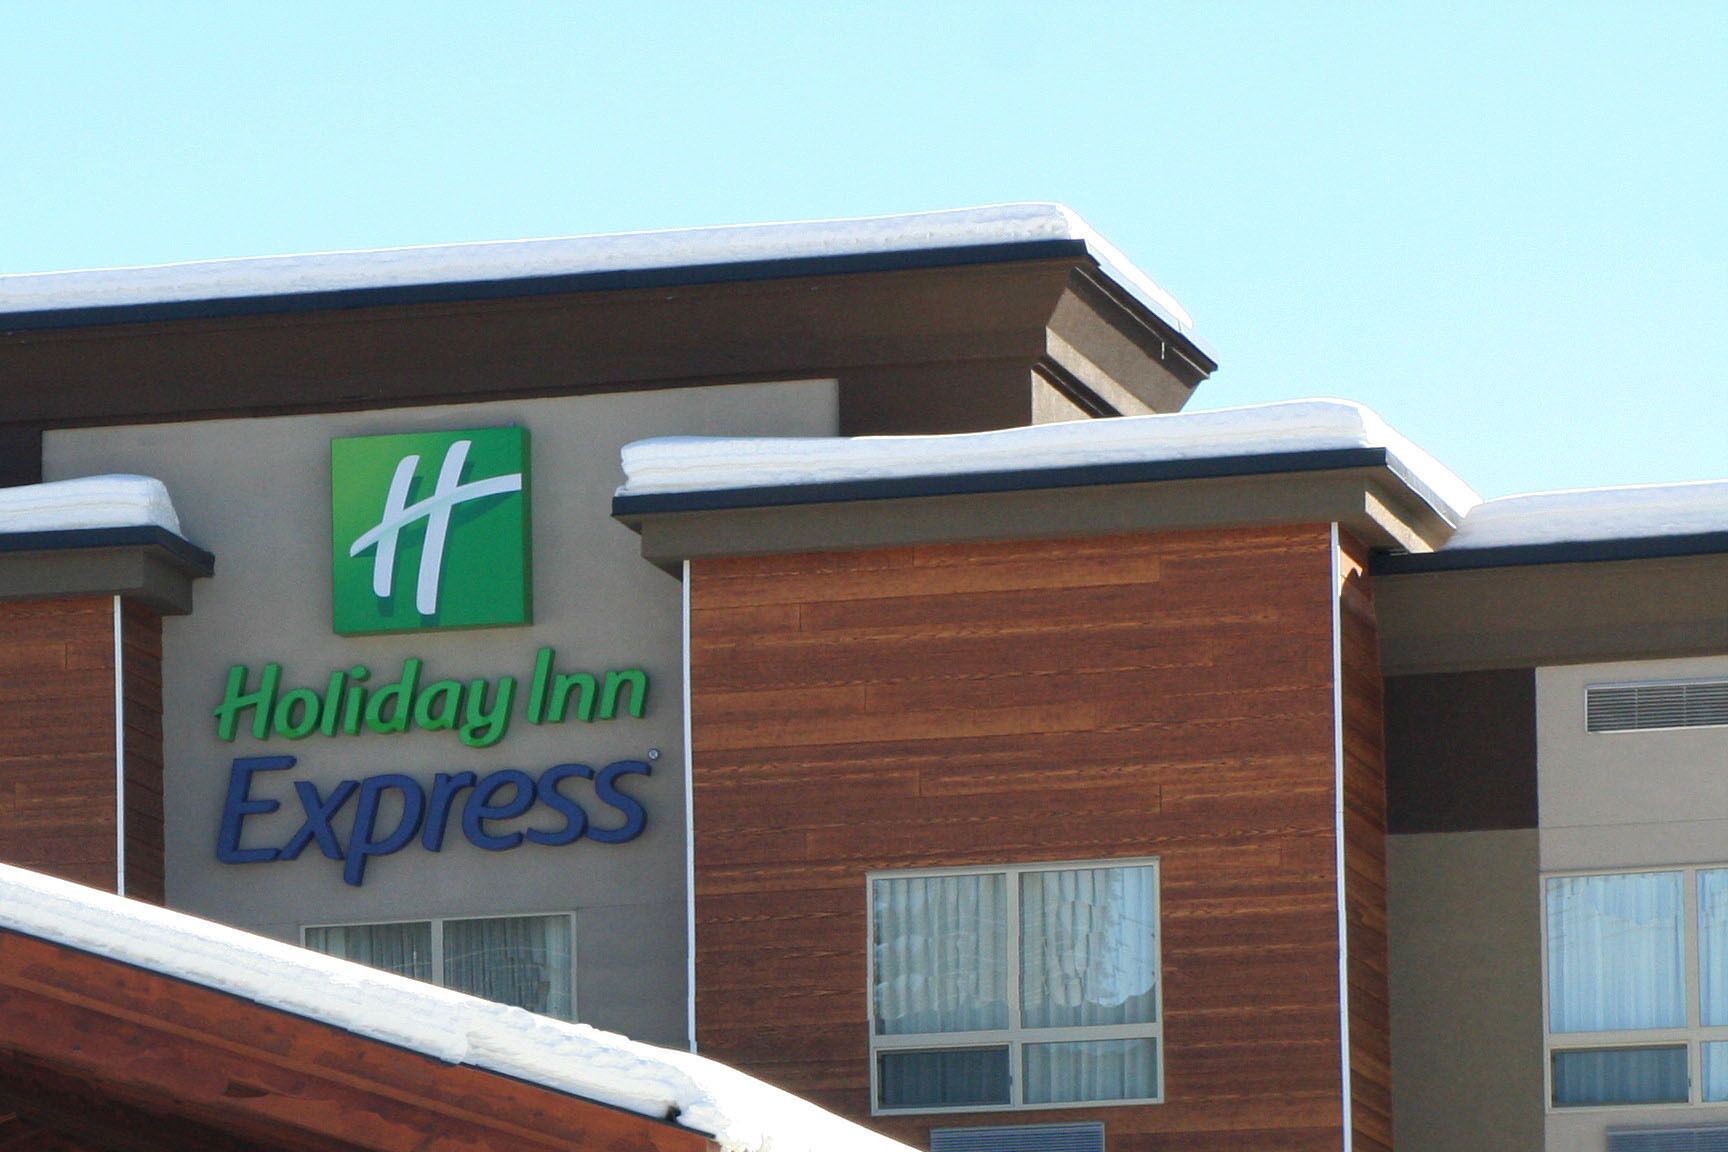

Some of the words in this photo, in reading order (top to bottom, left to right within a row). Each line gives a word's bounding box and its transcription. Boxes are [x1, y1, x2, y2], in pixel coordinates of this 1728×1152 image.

[212, 657, 517, 748] Holiday
[526, 646, 650, 726] Inn
[215, 755, 652, 887] Express
